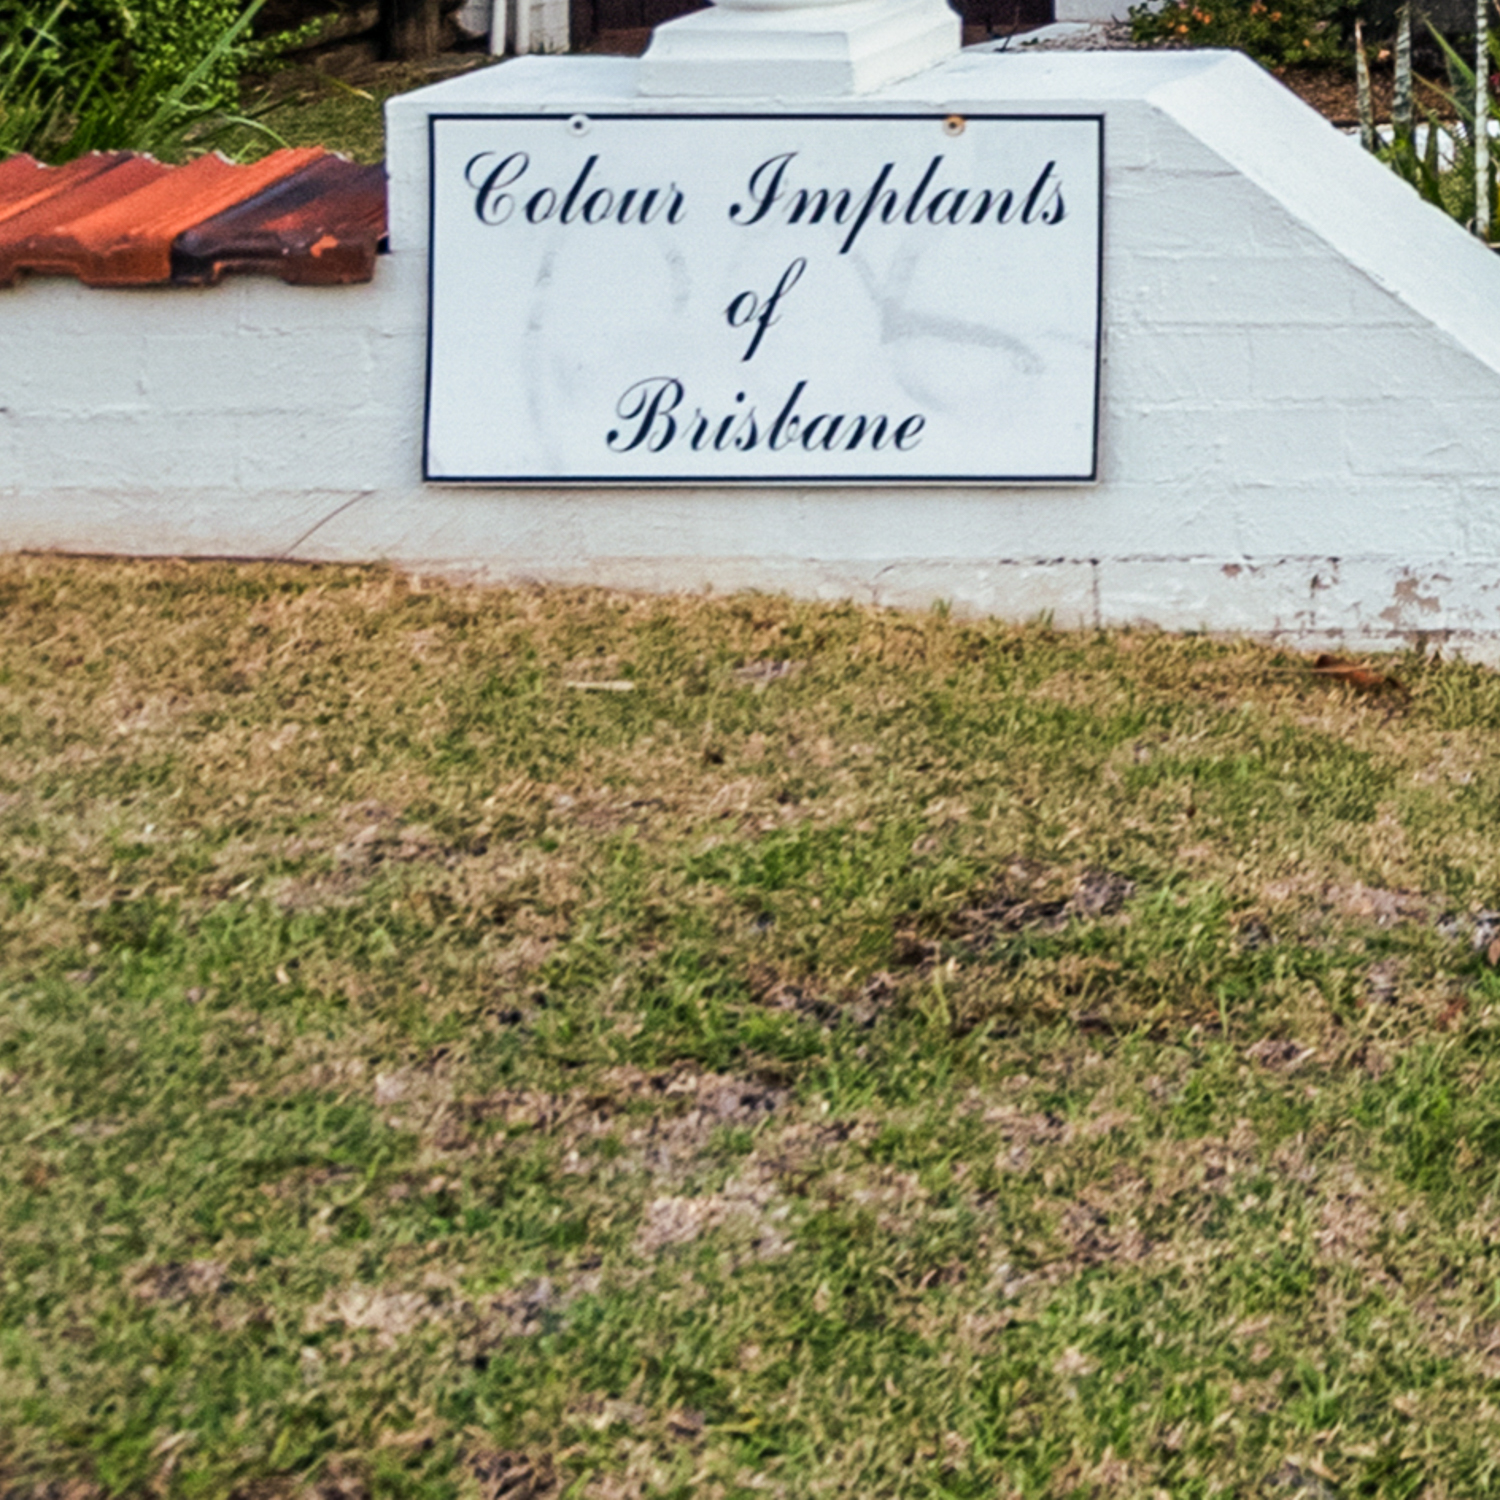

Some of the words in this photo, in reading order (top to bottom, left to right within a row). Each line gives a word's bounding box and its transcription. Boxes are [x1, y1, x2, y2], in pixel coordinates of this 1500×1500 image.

[465, 152, 686, 224] Colour
[729, 153, 1068, 254] Implants
[724, 259, 806, 361] of
[607, 376, 925, 452] Brisbane
